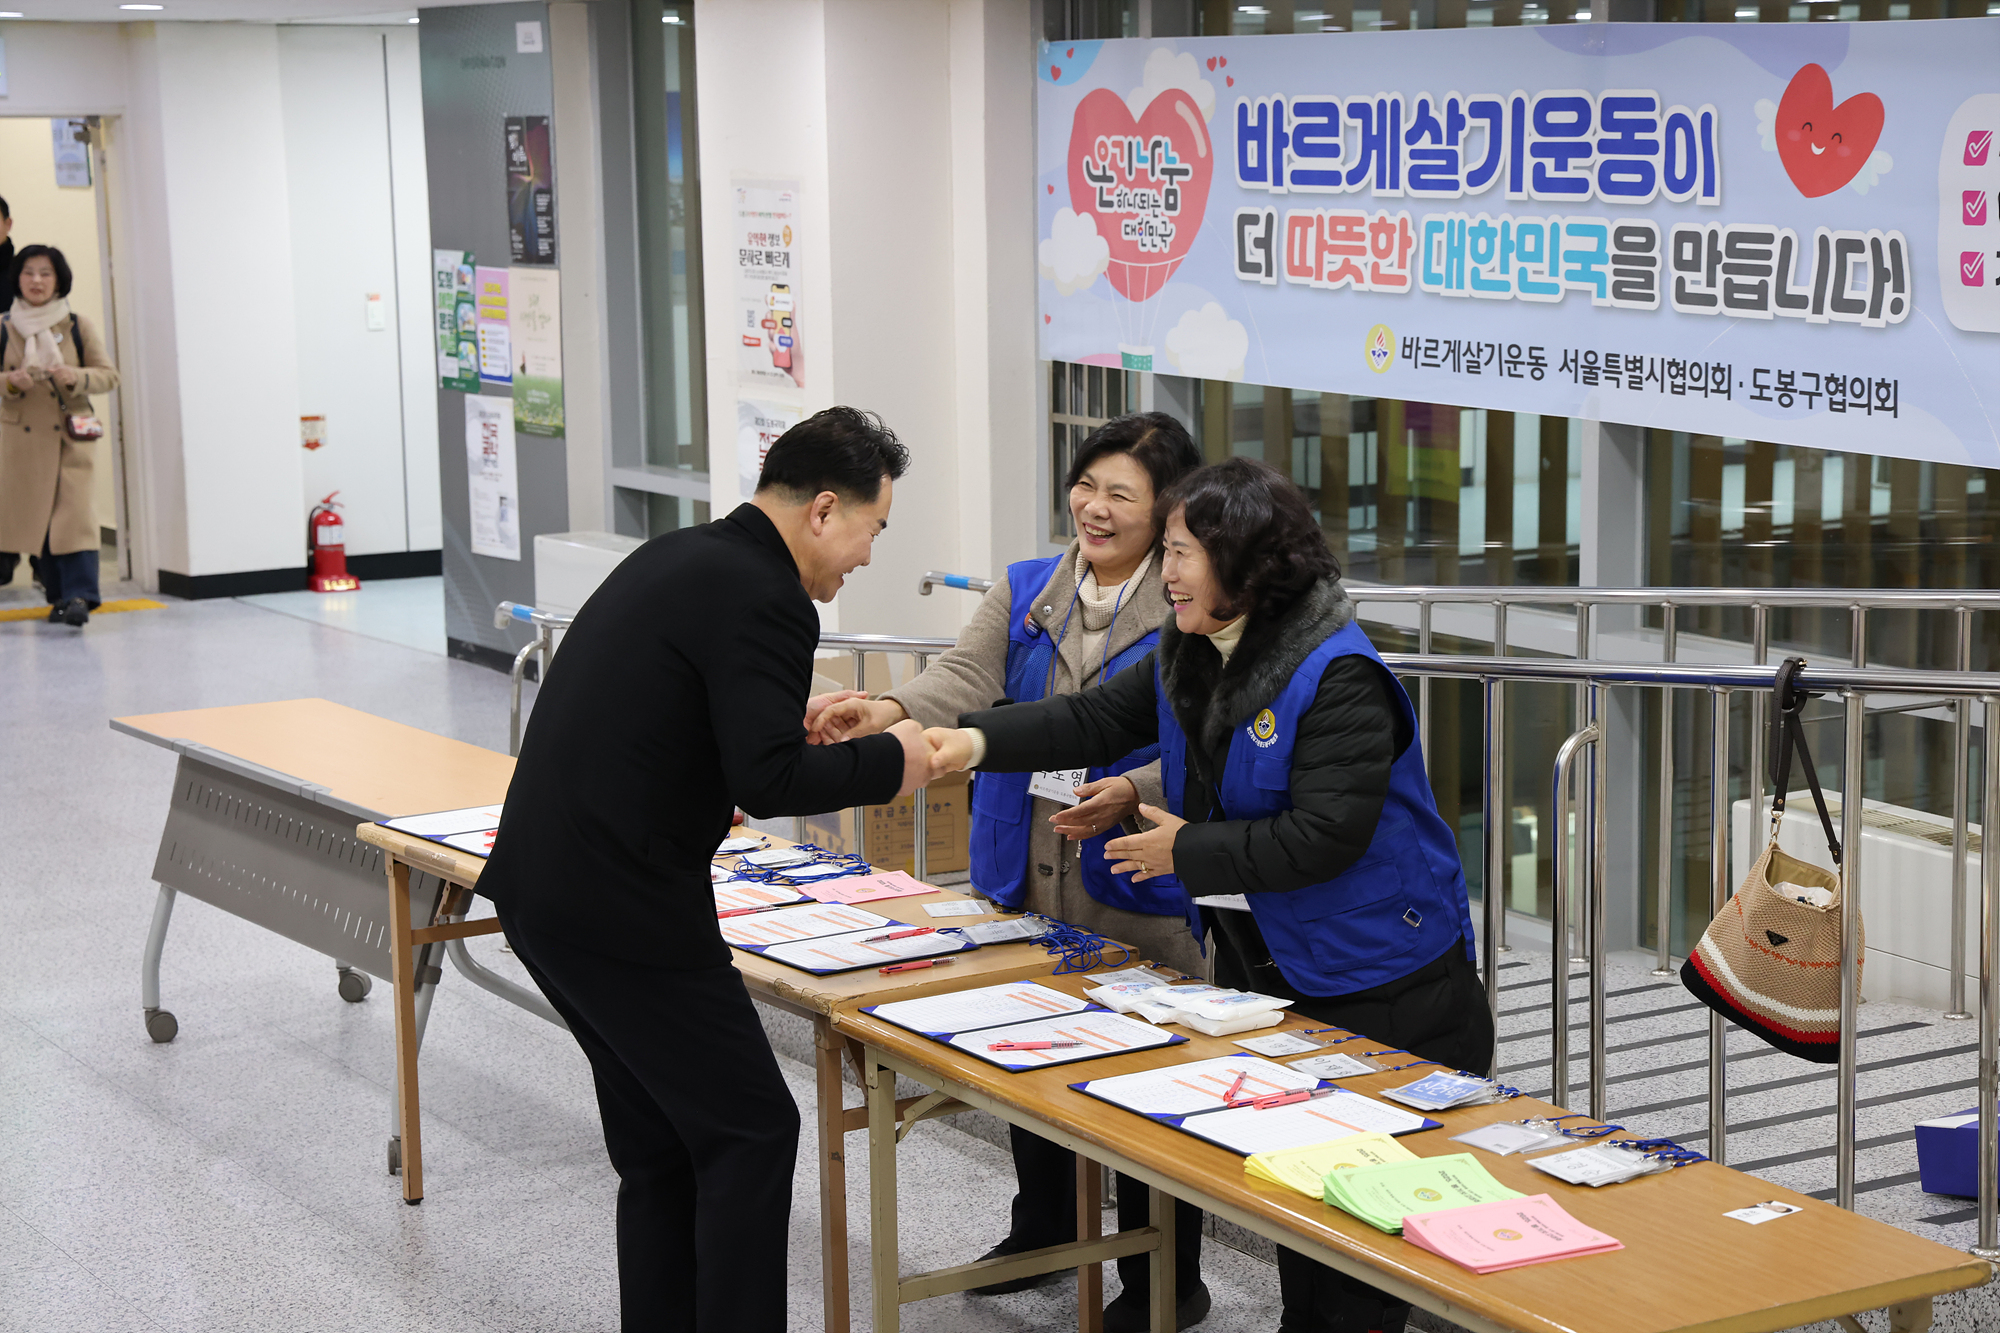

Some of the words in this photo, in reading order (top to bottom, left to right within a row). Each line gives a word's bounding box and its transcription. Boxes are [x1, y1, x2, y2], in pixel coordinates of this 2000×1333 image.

[1237, 96, 1715, 198] 바르게살기운동이
[1116, 188, 1161, 218] 하나되는
[1123, 217, 1174, 249] 대한민국
[1237, 212, 1274, 278] 더
[1286, 213, 1413, 287] 따뜻한
[1422, 218, 1657, 303] 대한민국을
[1673, 228, 1906, 320] 만듭니다!
[1401, 336, 1549, 381] 바르게살기운동
